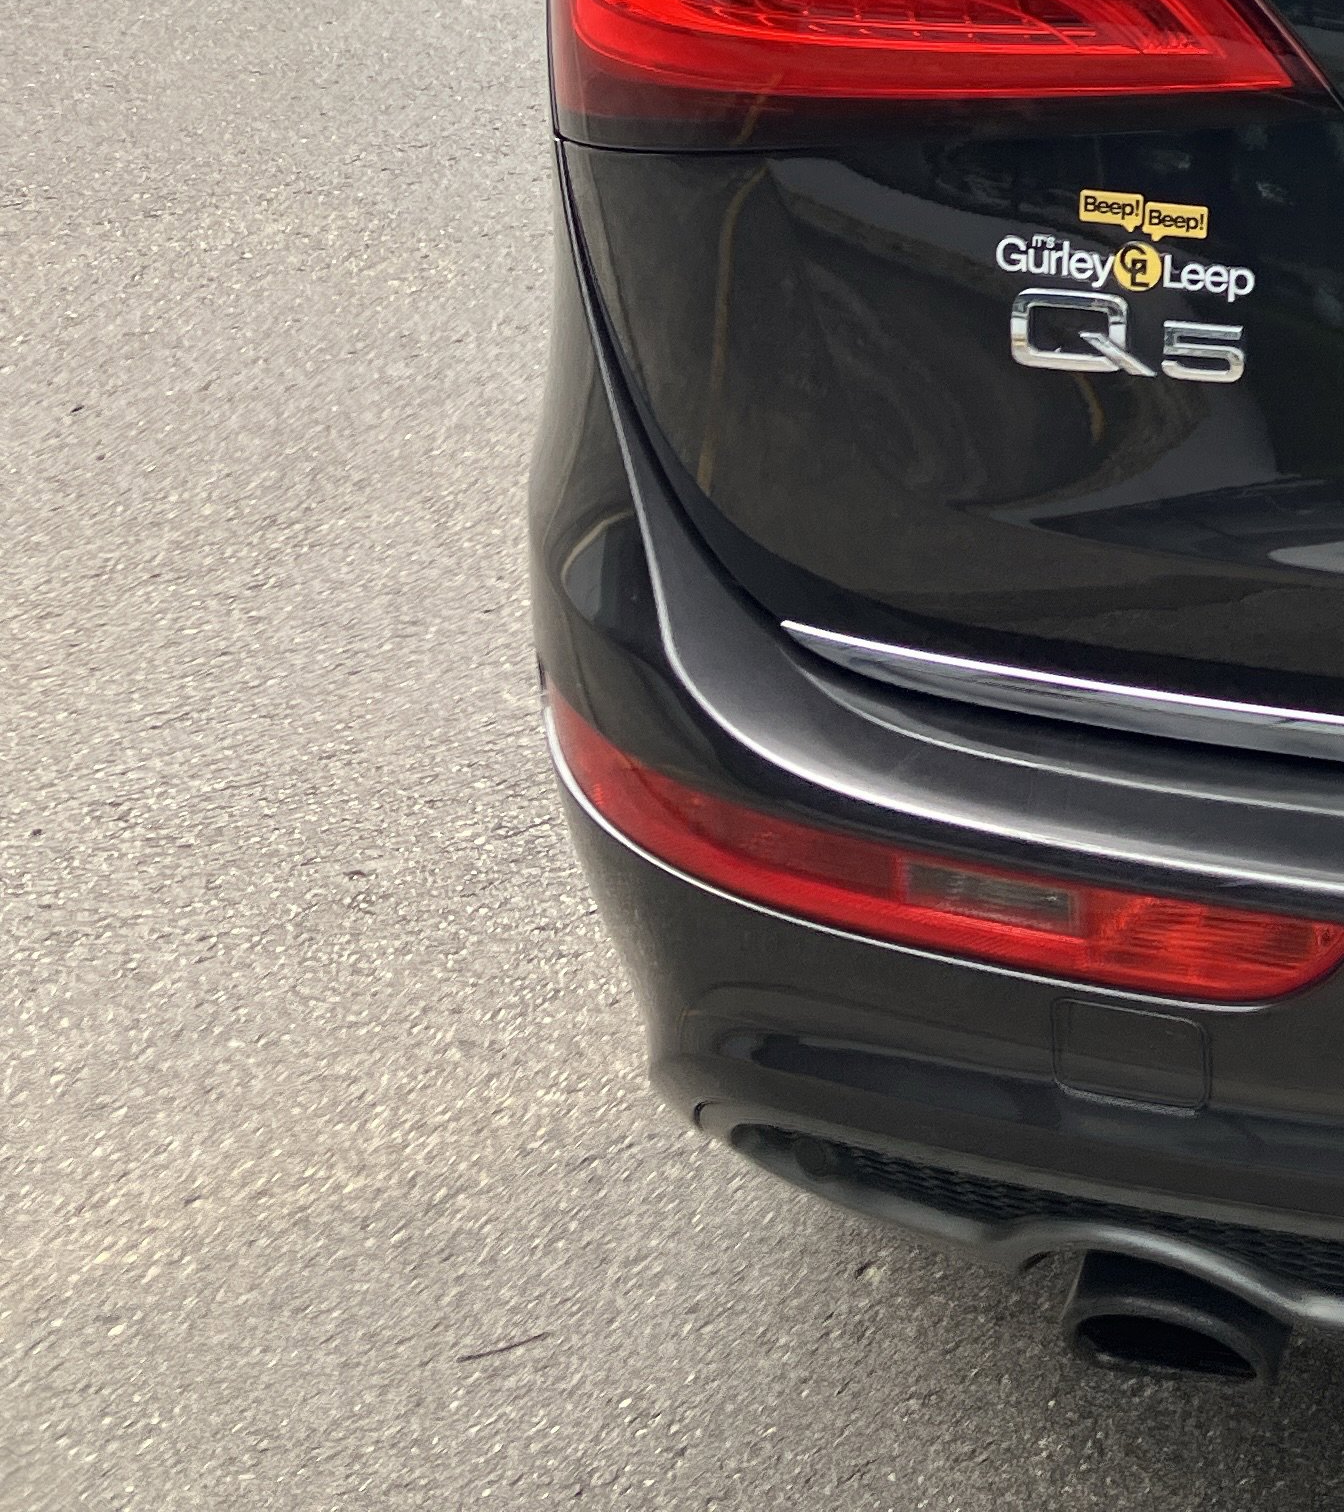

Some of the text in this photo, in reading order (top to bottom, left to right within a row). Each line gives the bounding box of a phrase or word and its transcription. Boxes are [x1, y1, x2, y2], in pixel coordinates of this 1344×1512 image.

[1083, 195, 1141, 218] Beep!
[1148, 209, 1205, 232] Beep!
[995, 236, 1115, 289] Gurley
[1162, 254, 1256, 303] Leep
[1010, 288, 1245, 383] Q5
